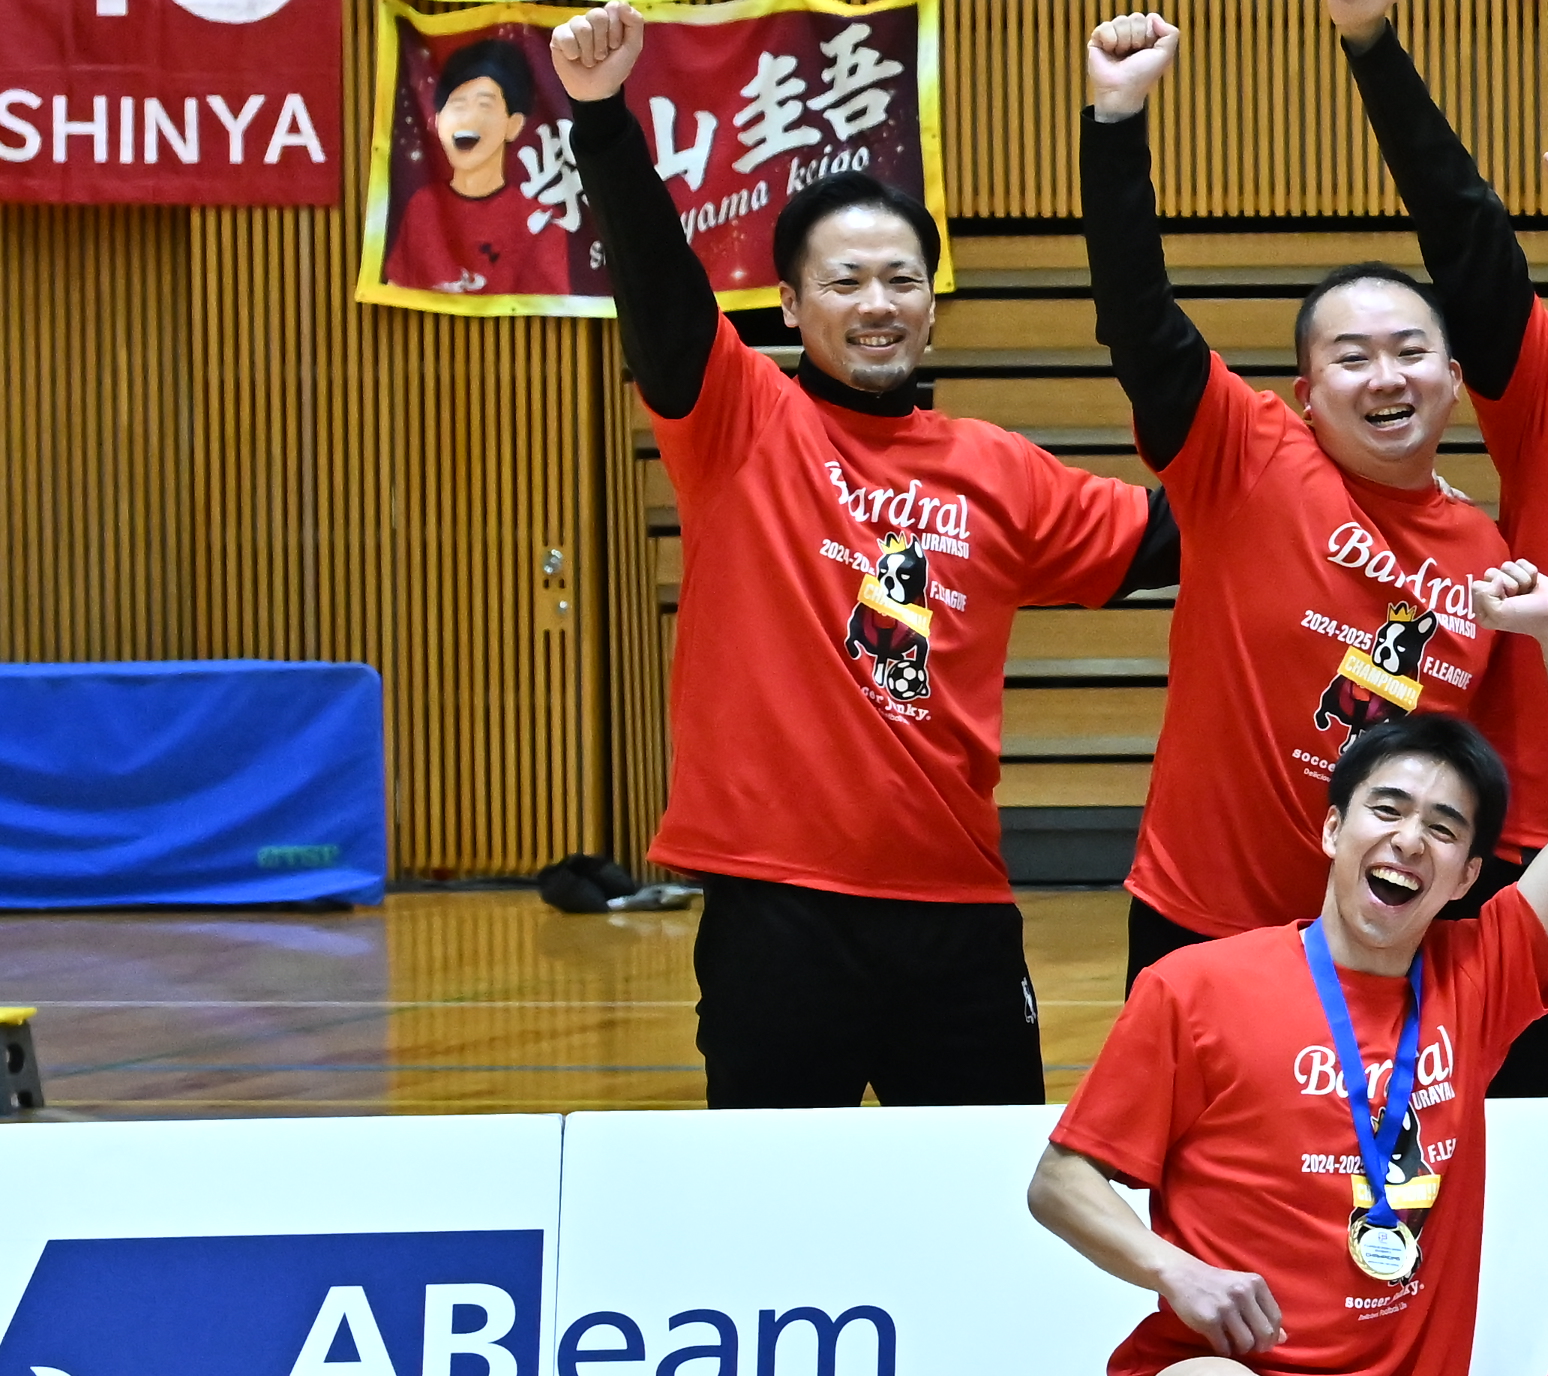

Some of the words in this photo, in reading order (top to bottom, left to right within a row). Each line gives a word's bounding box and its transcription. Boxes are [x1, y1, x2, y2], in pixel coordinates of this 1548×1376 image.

[0, 87, 326, 167] SHINYA
[922, 532, 970, 560] URAYASU
[1300, 610, 1373, 651] 2024-2025
[1423, 656, 1473, 691] F.LEAGUE
[1301, 1153, 1366, 1174] 2024-202
